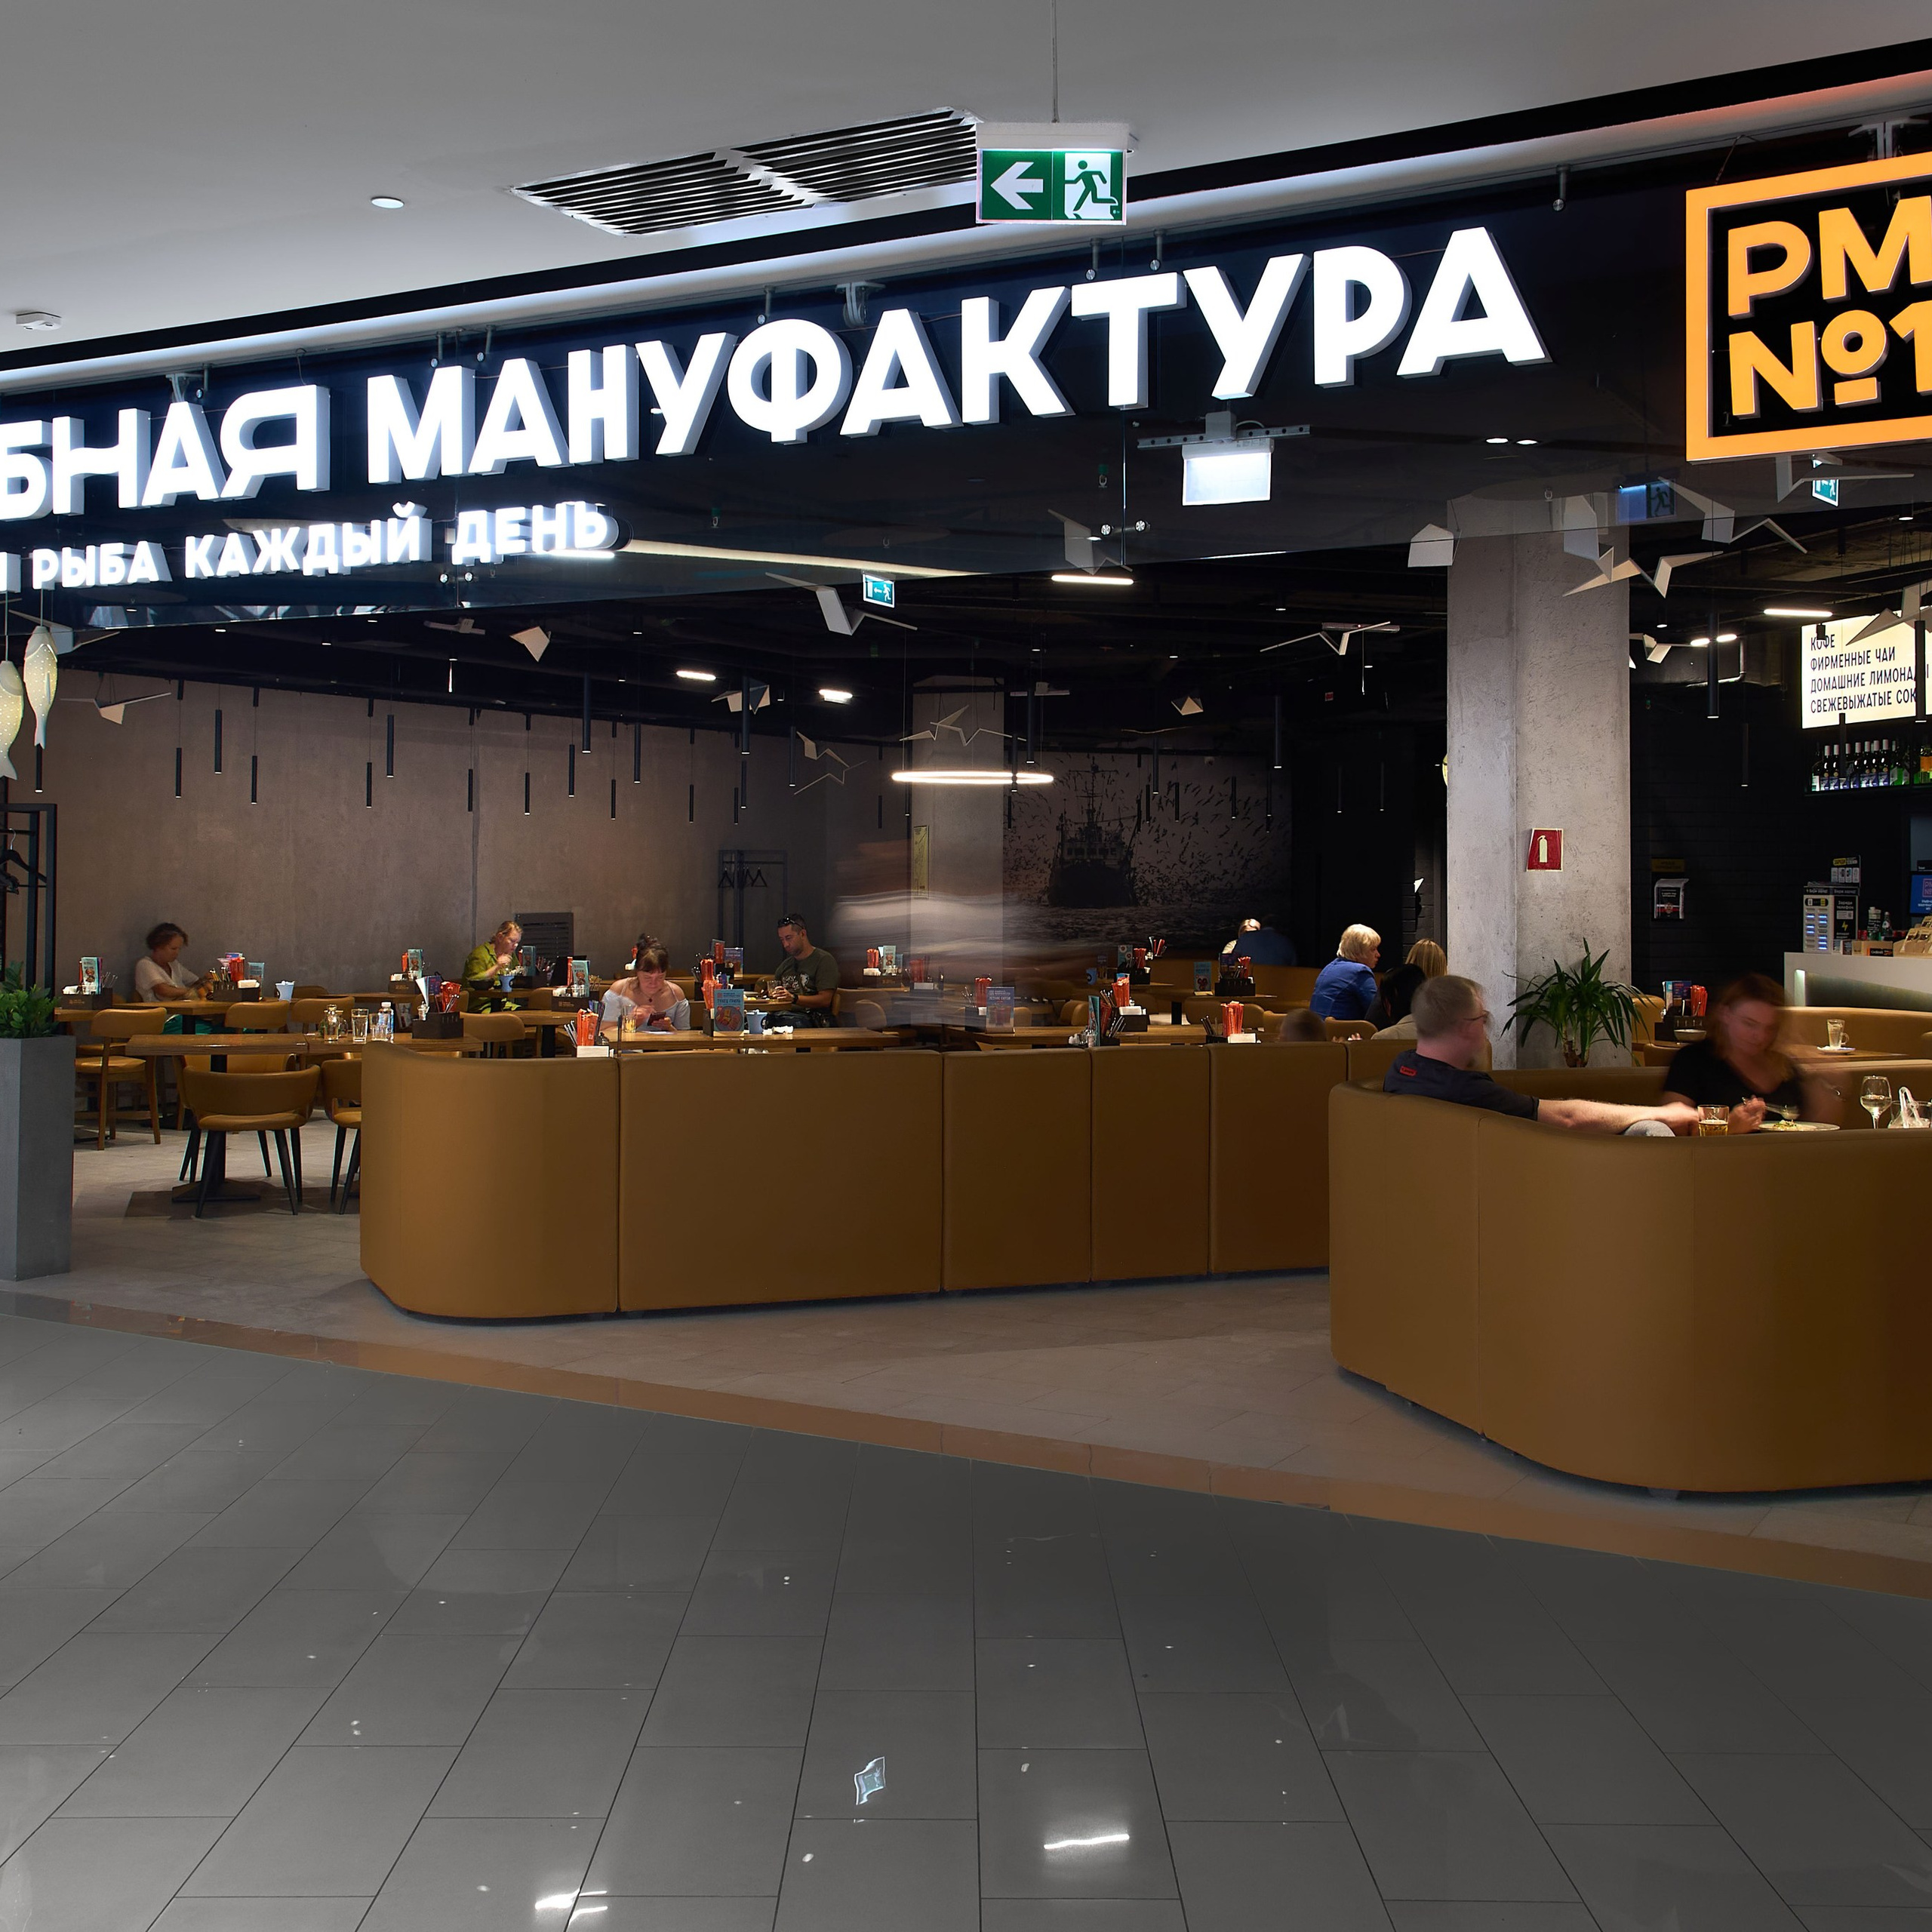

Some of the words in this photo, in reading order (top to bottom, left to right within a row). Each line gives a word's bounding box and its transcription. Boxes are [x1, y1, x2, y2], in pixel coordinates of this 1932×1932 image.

[368, 226, 1552, 485] МАНУФАКТУРА
[32, 540, 172, 590] РЫБА
[185, 501, 432, 580] КАЖДЫЙ
[452, 501, 619, 565] ДЕНЬ
[1810, 650, 1872, 672] ФИРМЕННЫЕ
[1875, 646, 1896, 663] ЧАИ
[1810, 672, 1866, 694] ДОМАШНИЕ
[1869, 664, 1930, 685] ЛИМОНА
[1810, 691, 1892, 713] СВЕЖЕВЫЖАТЫЕ
[1896, 688, 1916, 704] СОК
